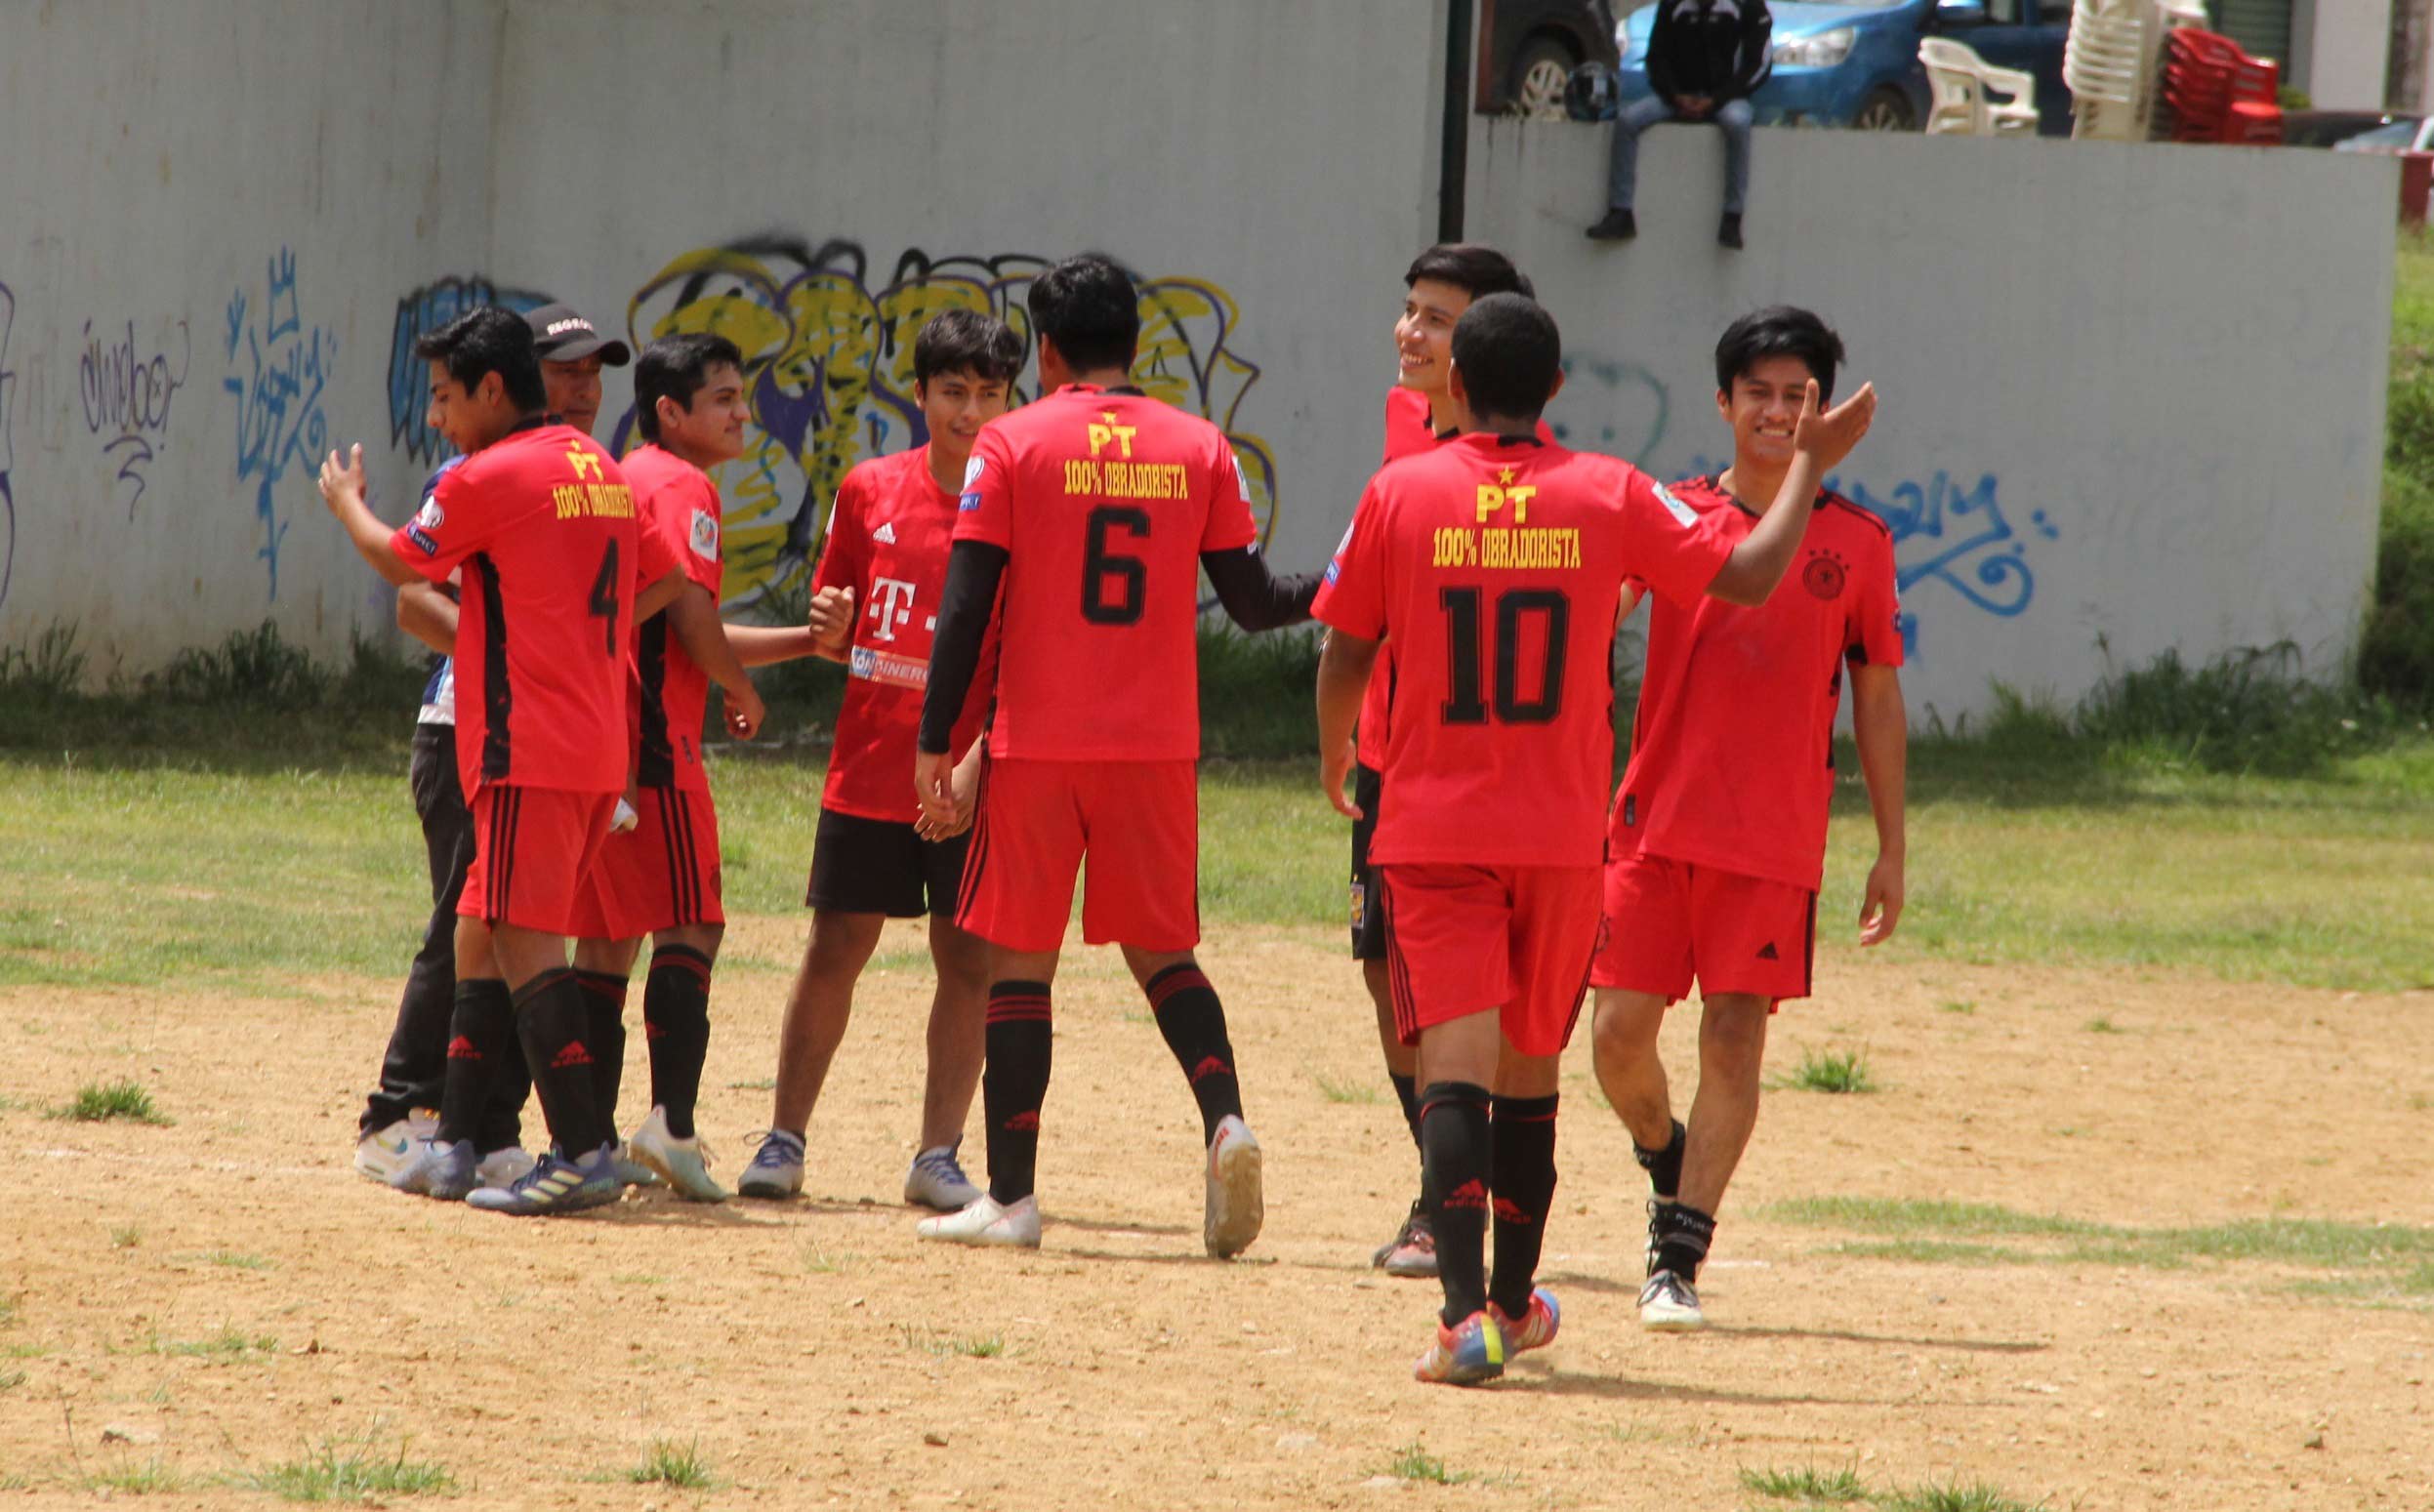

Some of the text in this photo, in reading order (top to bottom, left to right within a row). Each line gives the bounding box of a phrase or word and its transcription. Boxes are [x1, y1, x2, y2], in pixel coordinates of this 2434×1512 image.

[1089, 423, 1136, 458] PT
[566, 452, 603, 480] PT
[1064, 460, 1187, 499] 100% OBRADORISTA
[553, 484, 591, 519] 100%
[1476, 484, 1536, 523] PT
[1082, 504, 1150, 626] 6
[1433, 527, 1581, 569] 100% OBRADORISTA
[589, 536, 618, 657] 4
[1440, 586, 1570, 725] 10
